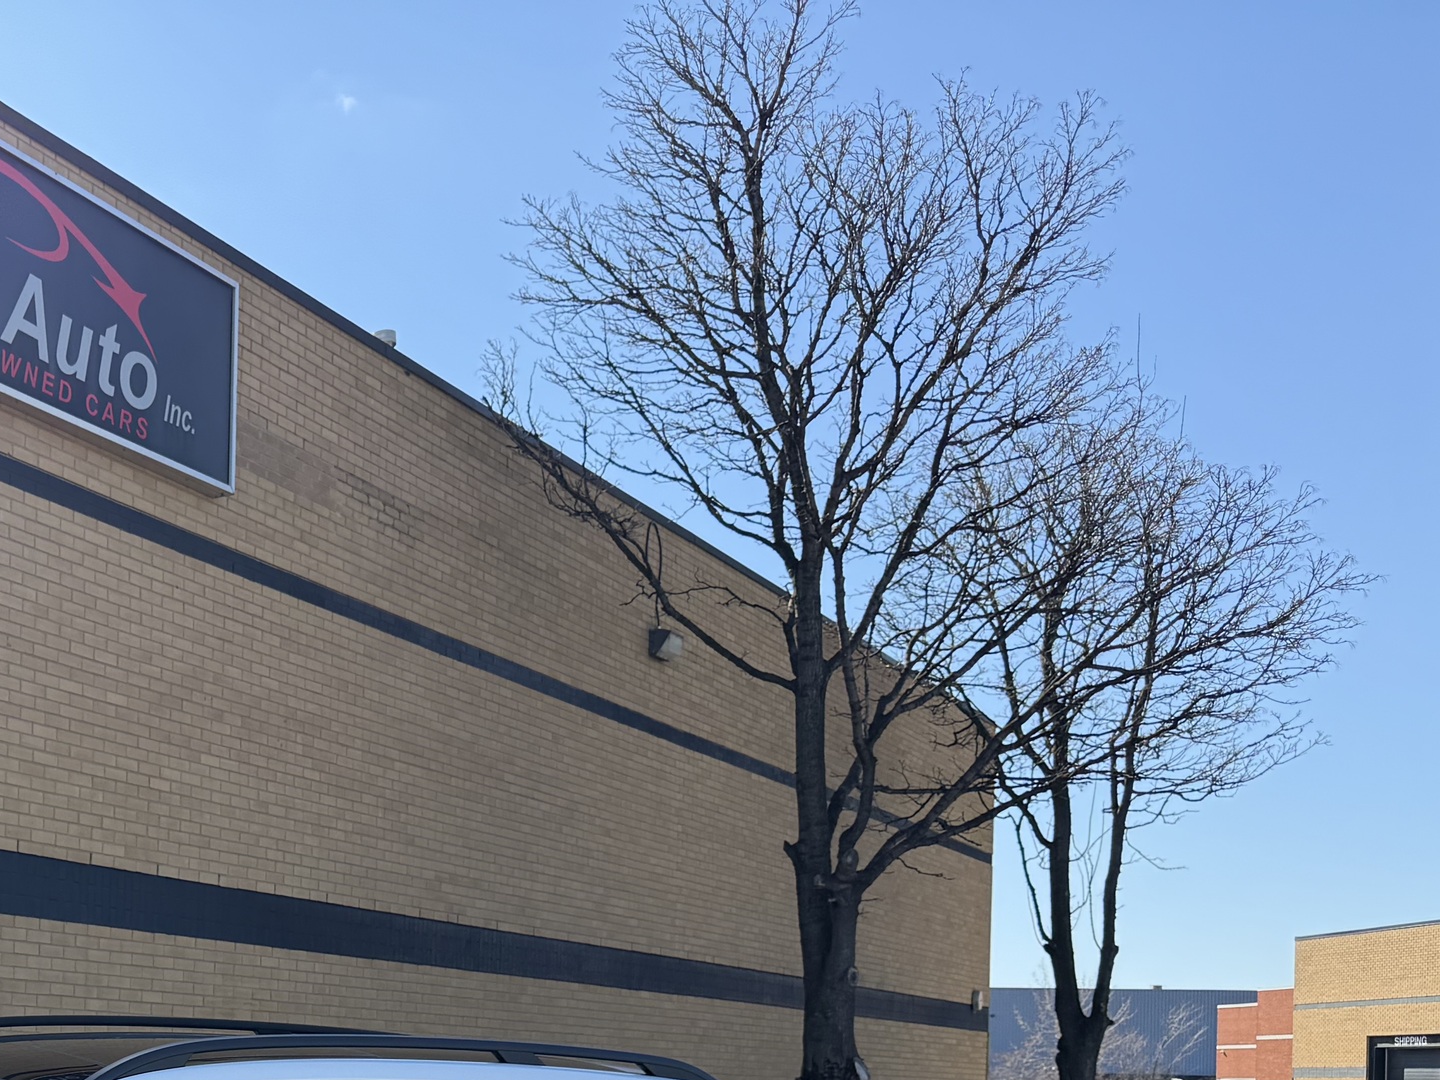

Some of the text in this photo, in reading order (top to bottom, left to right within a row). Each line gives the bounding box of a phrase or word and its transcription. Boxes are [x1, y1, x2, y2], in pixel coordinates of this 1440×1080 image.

[0, 273, 158, 410] Auto
[164, 395, 195, 435] Inc.
[85, 394, 149, 440] CARS
[1394, 1035, 1427, 1046] SHIPPING
